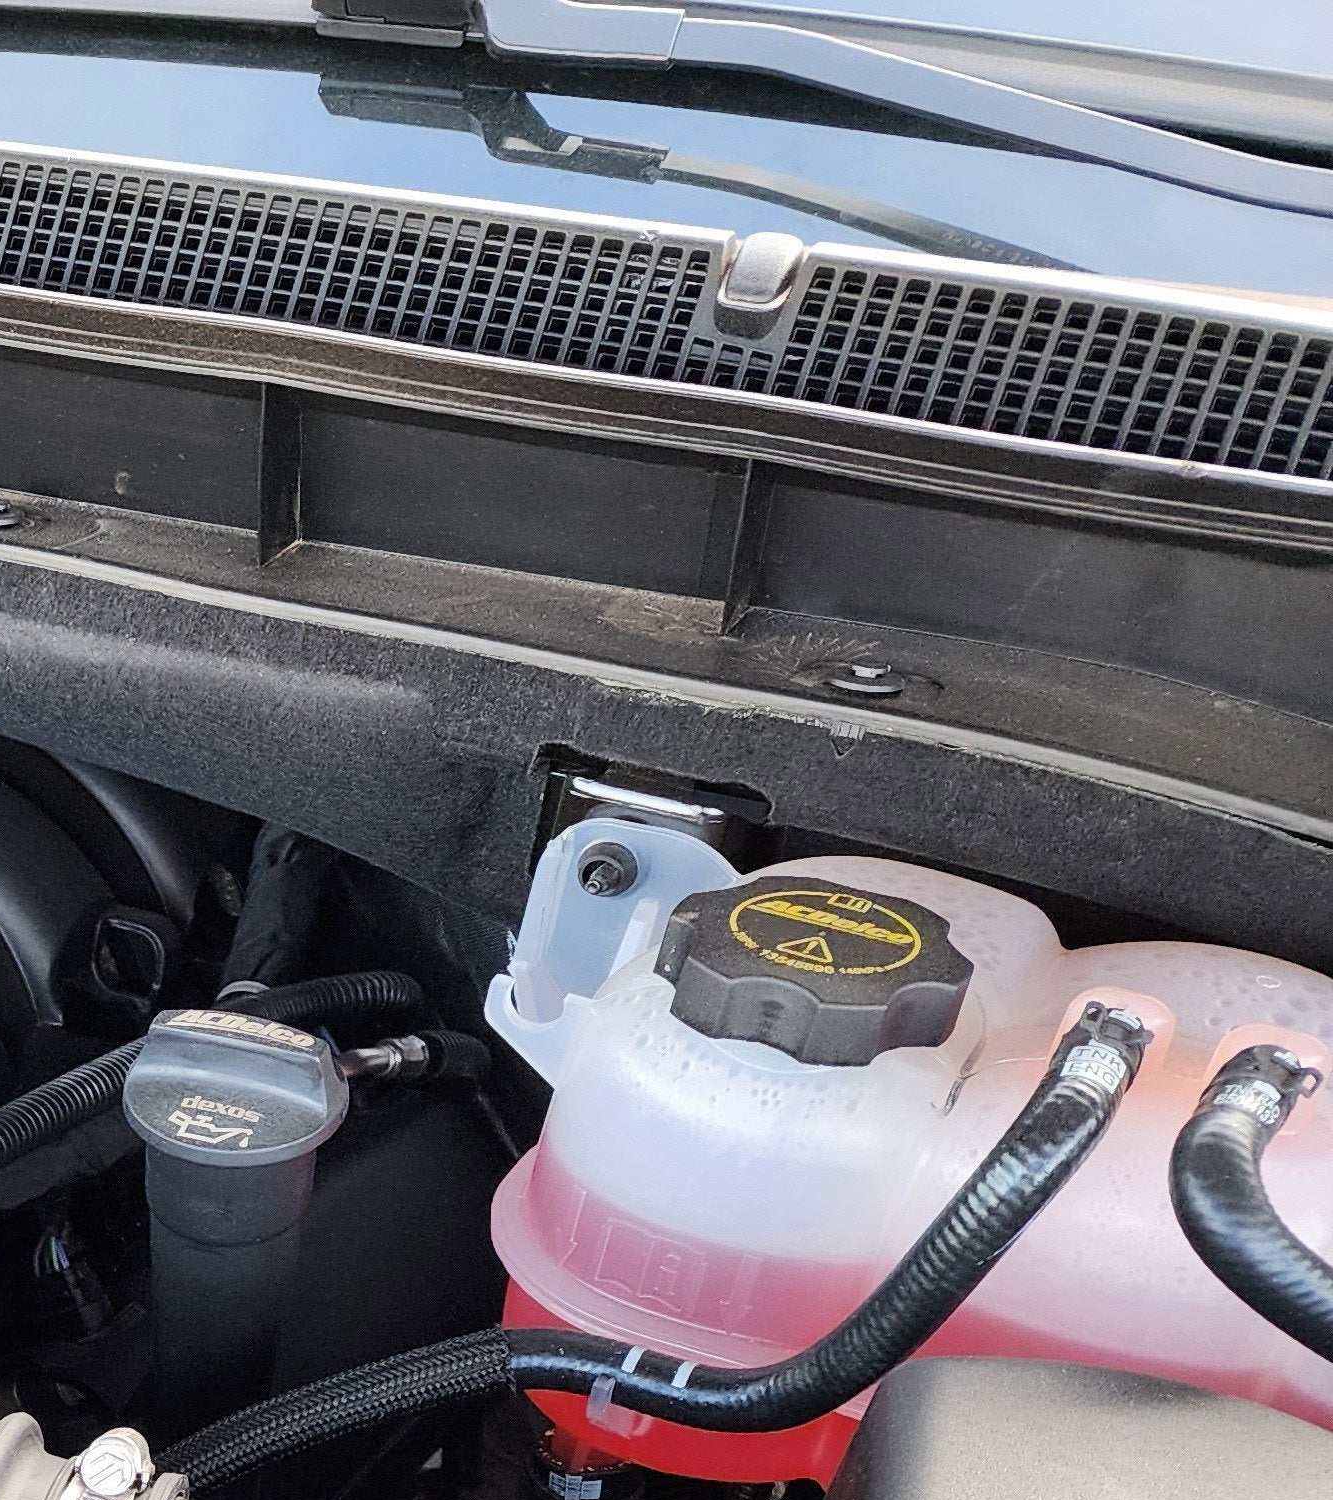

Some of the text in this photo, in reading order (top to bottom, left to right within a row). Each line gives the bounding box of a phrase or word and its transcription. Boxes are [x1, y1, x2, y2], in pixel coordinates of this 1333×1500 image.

[753, 900, 915, 945] ACDelco
[170, 1009, 315, 1049] ACDelco
[1067, 1061, 1116, 1087] ENG
[1077, 1047, 1122, 1074] TNK
[181, 1095, 263, 1124] dexos
